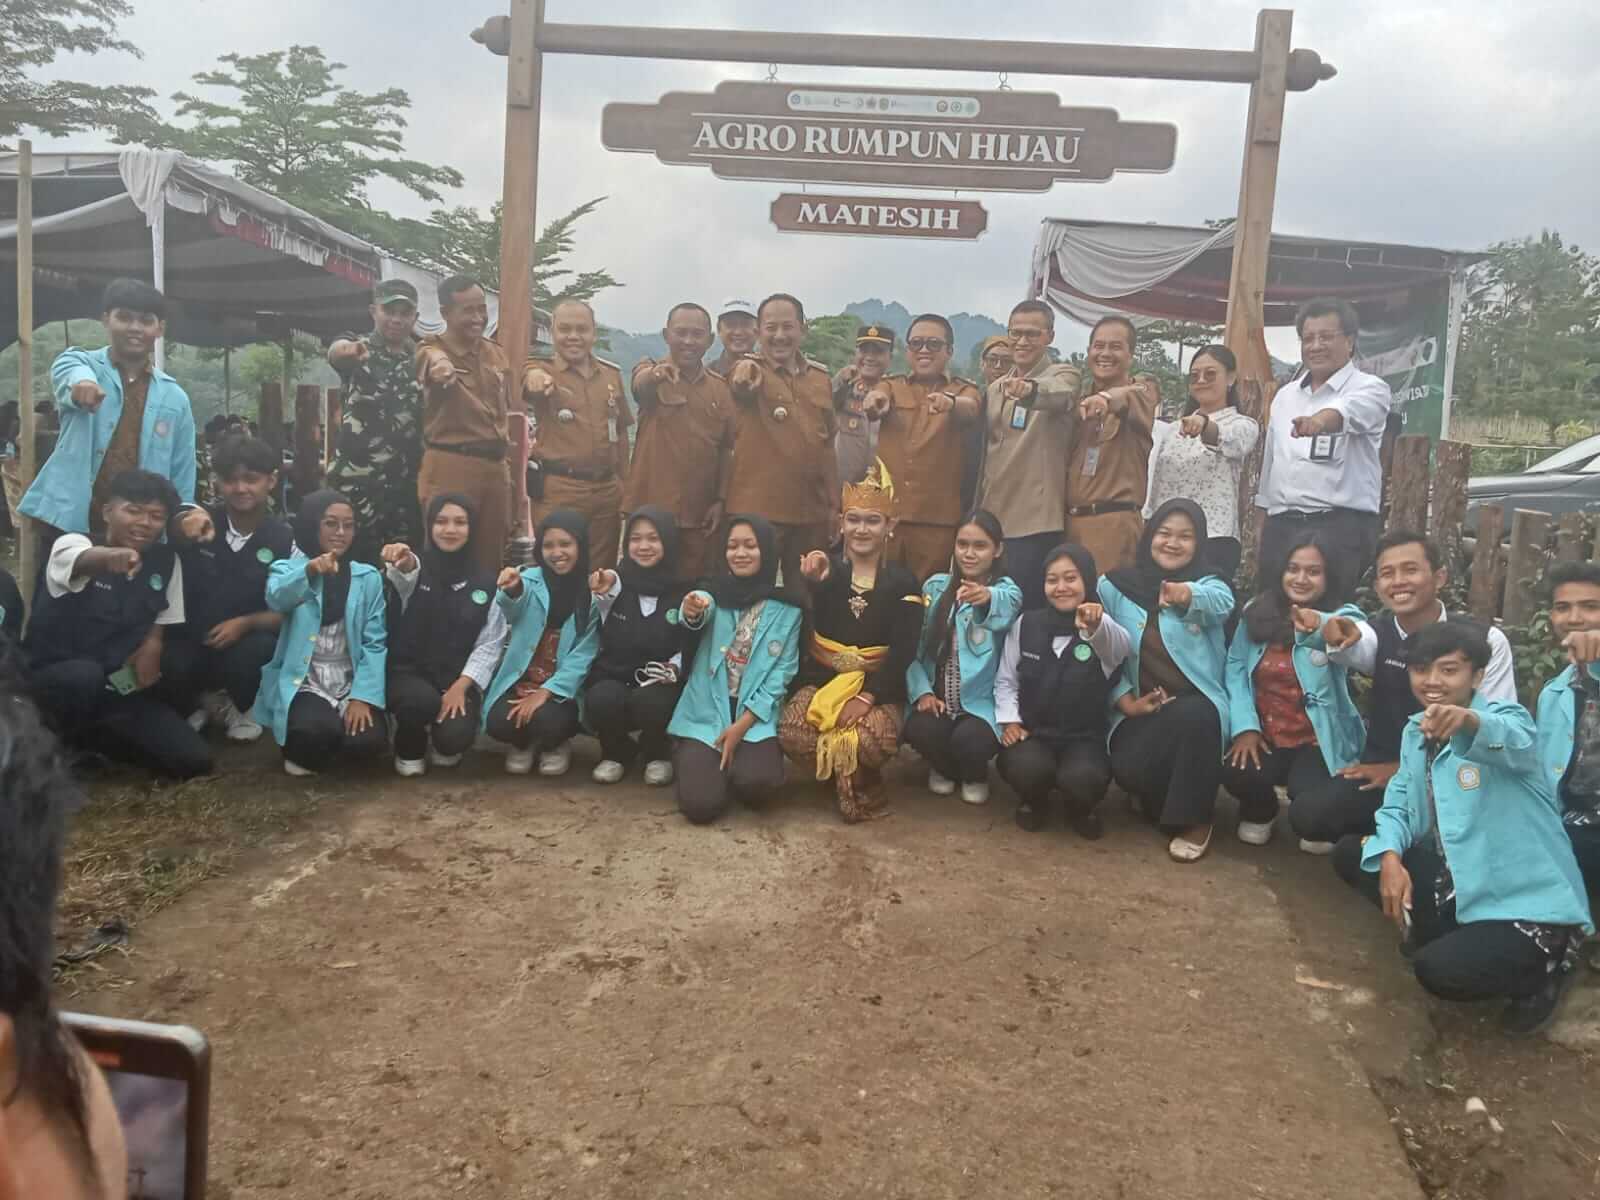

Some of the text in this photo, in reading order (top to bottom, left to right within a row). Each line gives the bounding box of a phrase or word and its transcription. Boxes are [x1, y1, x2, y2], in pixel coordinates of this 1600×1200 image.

[693, 121, 1080, 164] AGRO RUMPUN HIJAU
[797, 202, 961, 230] MATESIH
